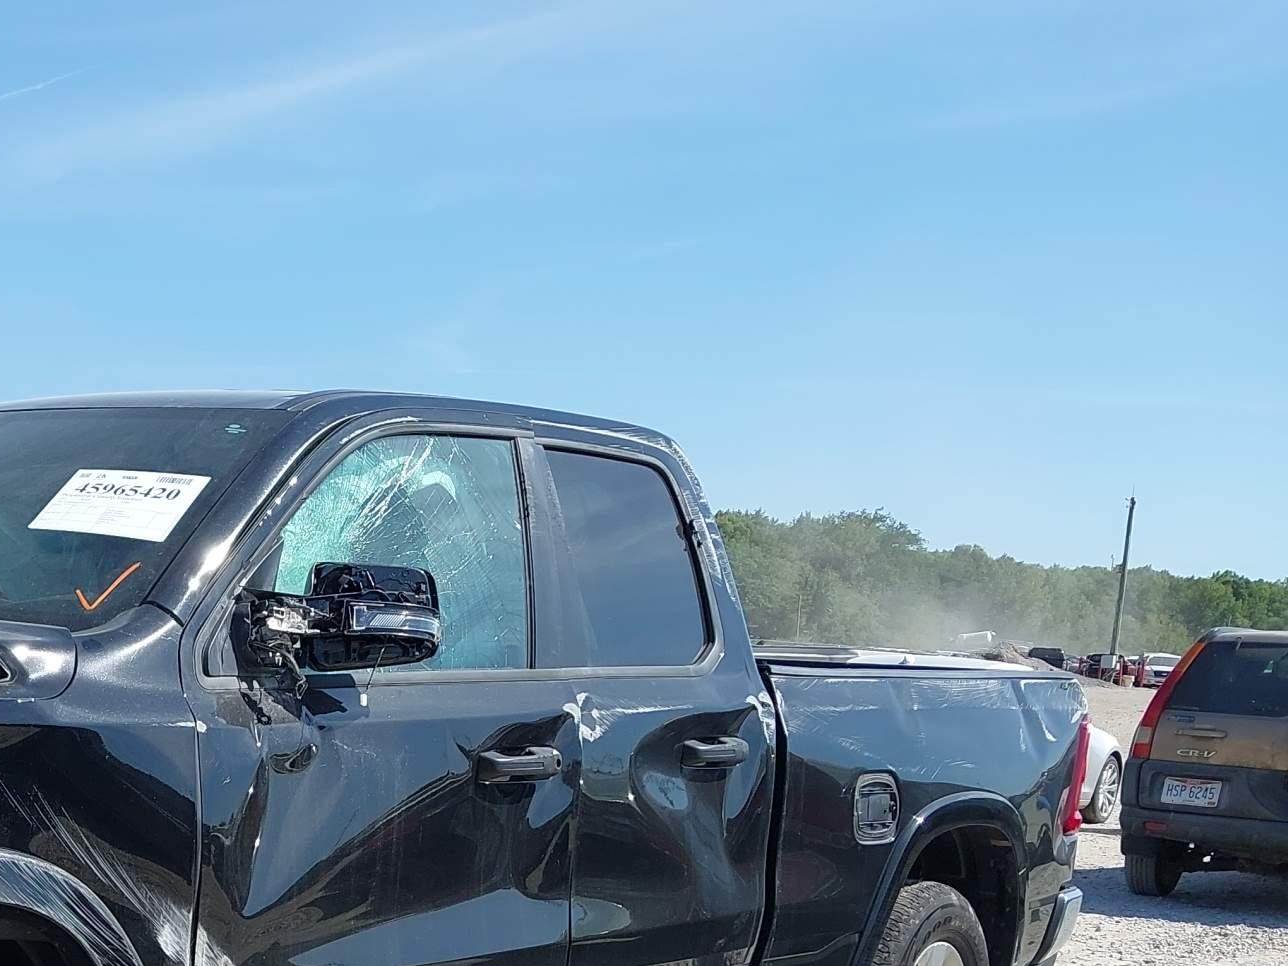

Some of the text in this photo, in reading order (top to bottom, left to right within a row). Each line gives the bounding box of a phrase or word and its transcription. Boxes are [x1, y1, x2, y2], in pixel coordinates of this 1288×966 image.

[75, 482, 181, 501] 45965420
[1176, 748, 1217, 758] CR-V
[1166, 783, 1216, 800] HSP 6245
